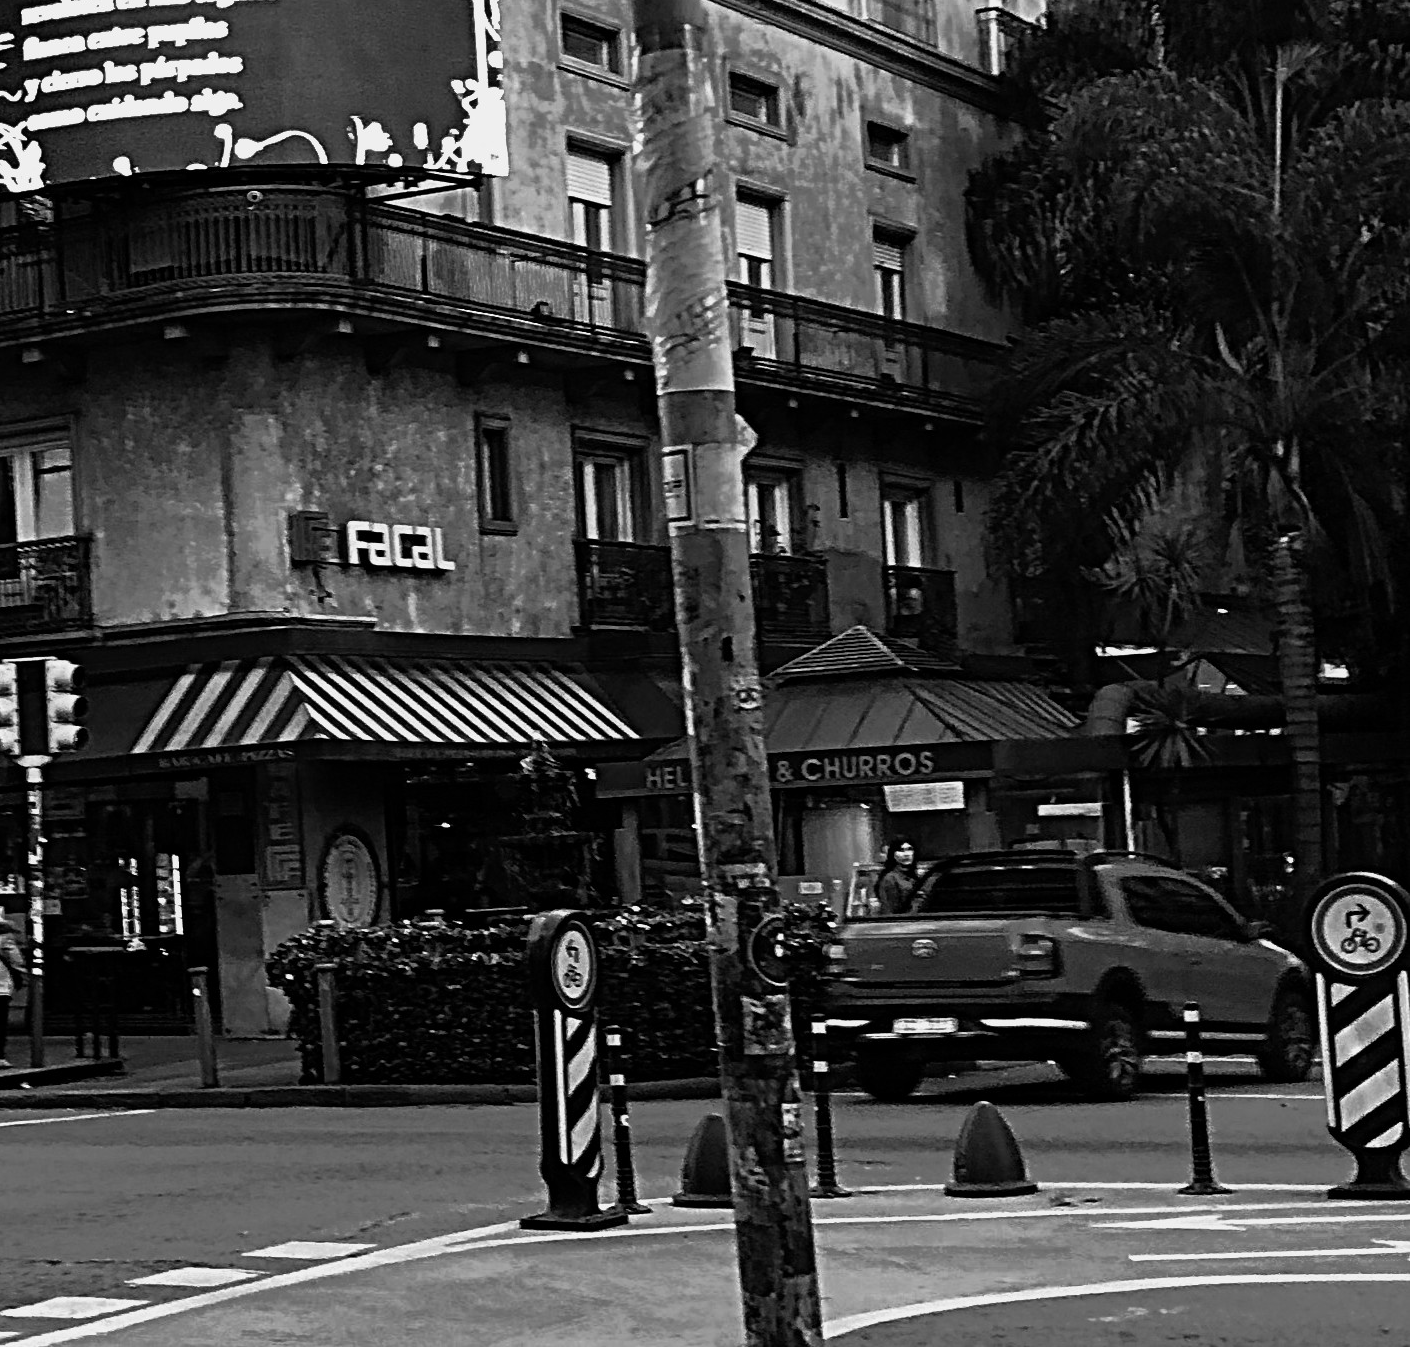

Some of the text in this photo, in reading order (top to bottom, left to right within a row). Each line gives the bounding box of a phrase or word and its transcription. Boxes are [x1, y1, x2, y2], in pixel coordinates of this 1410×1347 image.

[646, 751, 934, 789] HEL & CHURROS
